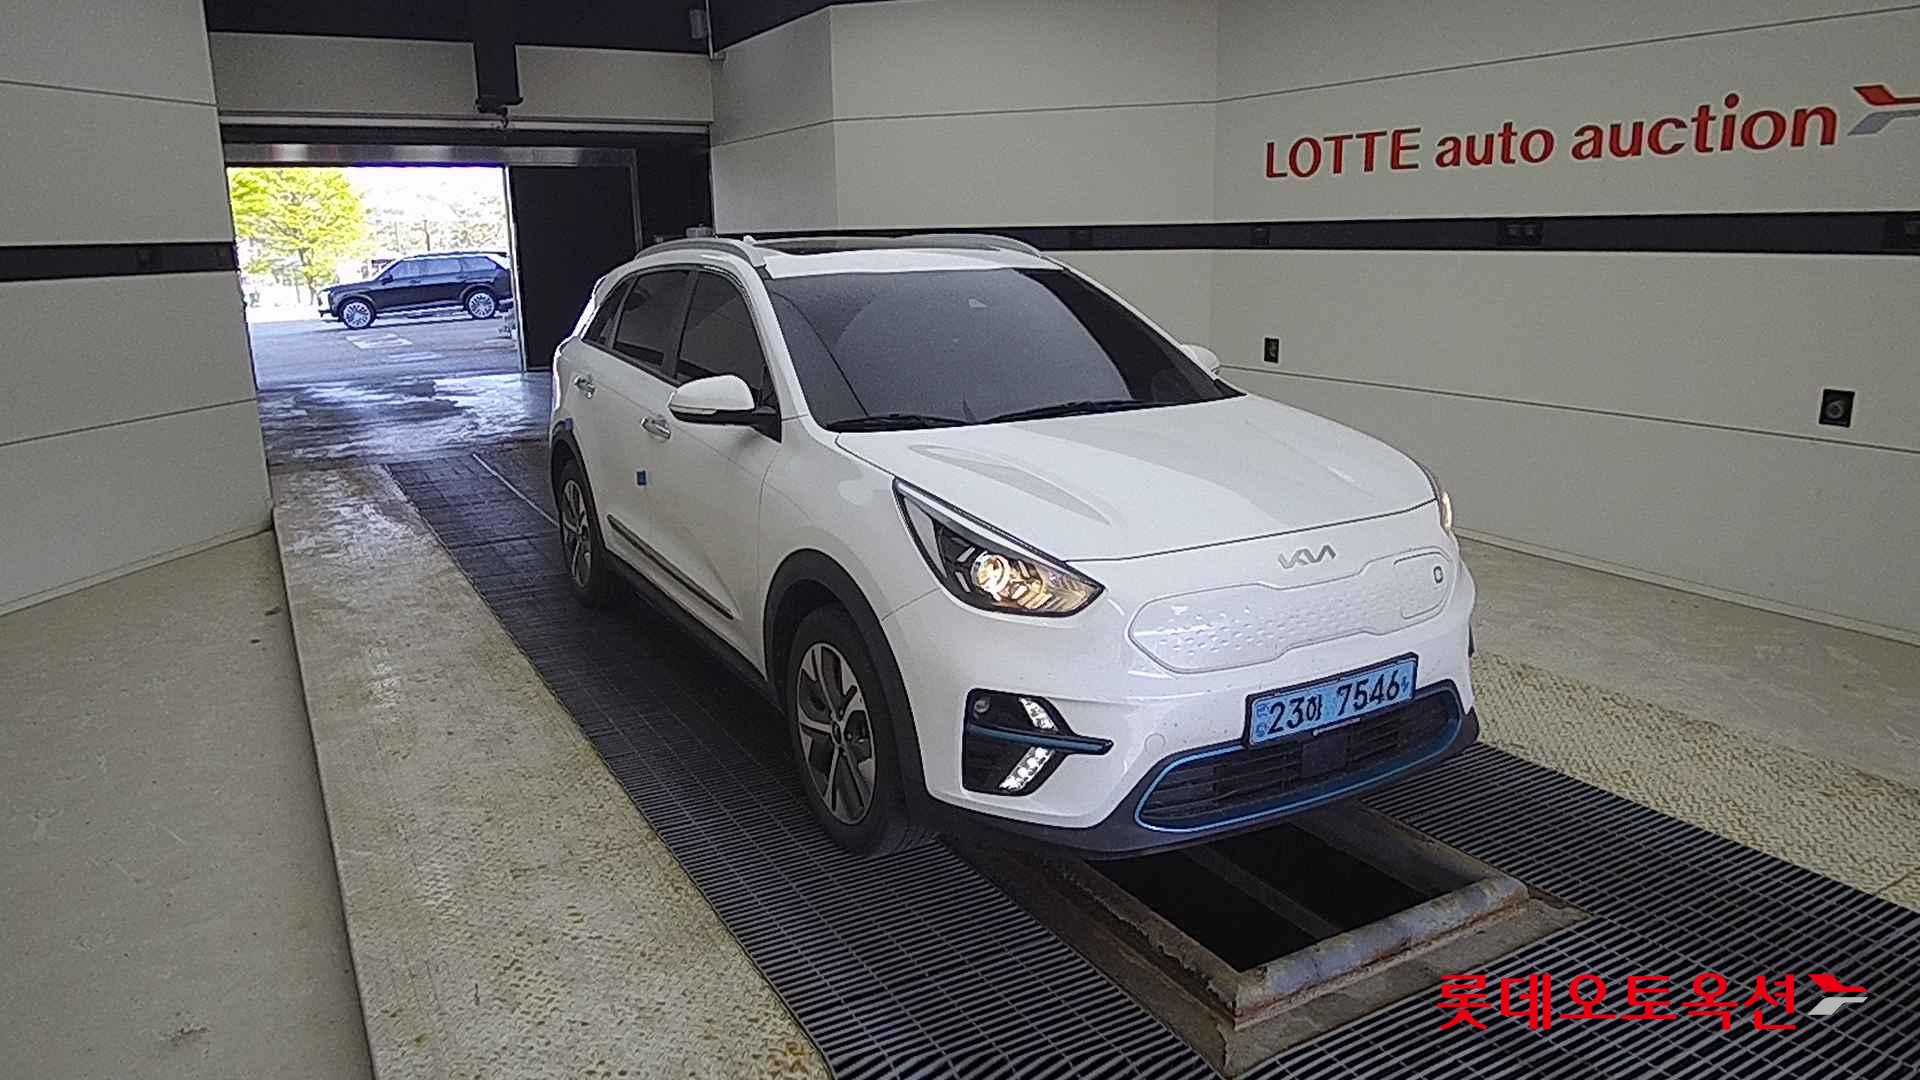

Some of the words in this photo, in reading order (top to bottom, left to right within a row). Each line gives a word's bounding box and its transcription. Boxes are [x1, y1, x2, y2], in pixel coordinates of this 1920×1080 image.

[1265, 127, 1422, 179] LOTTE
[1435, 121, 1555, 169] auto
[1570, 92, 1838, 162] auction
[1336, 669, 1400, 717] 7546
